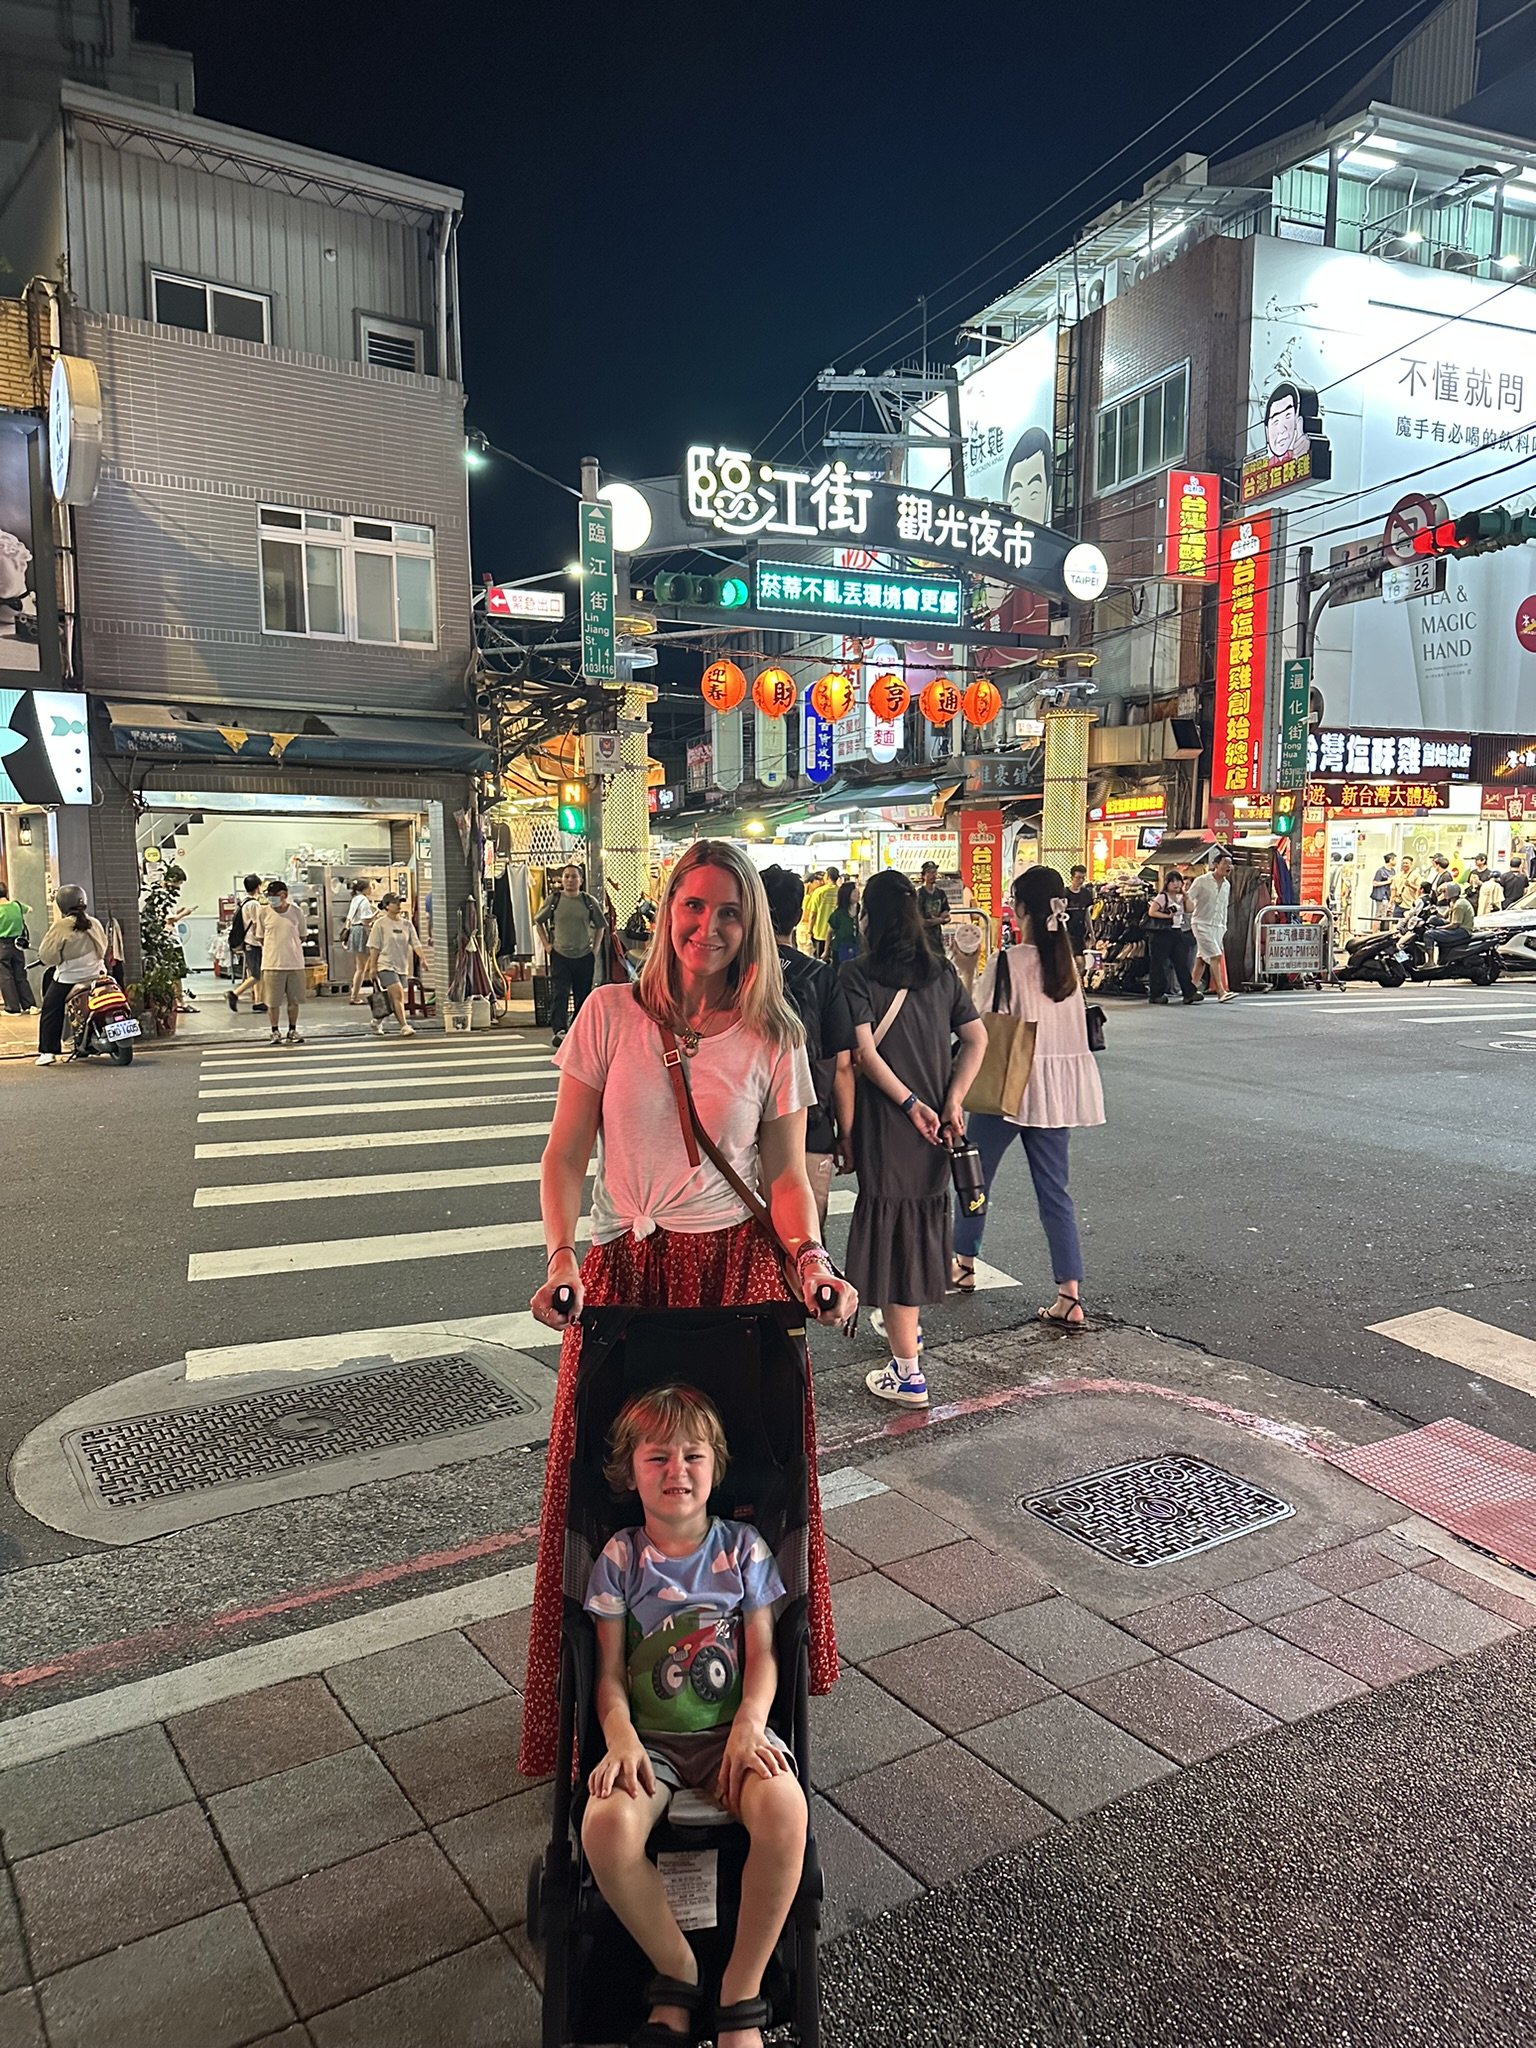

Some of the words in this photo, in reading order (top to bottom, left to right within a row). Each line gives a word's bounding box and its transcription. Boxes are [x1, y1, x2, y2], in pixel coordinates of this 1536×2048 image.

[1398, 357, 1523, 413] 不懂就問
[1395, 415, 1536, 455] 魔手有必喝的飲料
[686, 444, 873, 536] 臨江街
[896, 493, 1035, 569] 觀光夜市
[588, 522, 608, 612] 臨江街
[1414, 563, 1429, 577] 12
[1071, 575, 1099, 587] TAIPEI
[1388, 586, 1401, 598] 18
[1414, 577, 1430, 591] 24
[761, 572, 958, 615] 菸蒂不亂丟環境會更優
[1456, 584, 1468, 602] &
[584, 612, 599, 622] Lin
[1422, 611, 1477, 635] MAGIC
[584, 624, 610, 637] Jiang
[585, 635, 597, 645] St.
[604, 648, 610, 657] 4
[1423, 639, 1472, 661] HAND
[584, 662, 598, 673] 103
[601, 664, 614, 675] 116
[707, 668, 726, 701] 迎春
[773, 680, 794, 707] 財
[884, 683, 906, 711] 亨
[938, 687, 958, 715] 通
[1283, 742, 1302, 751] Tong
[1282, 760, 1293, 768] St.
